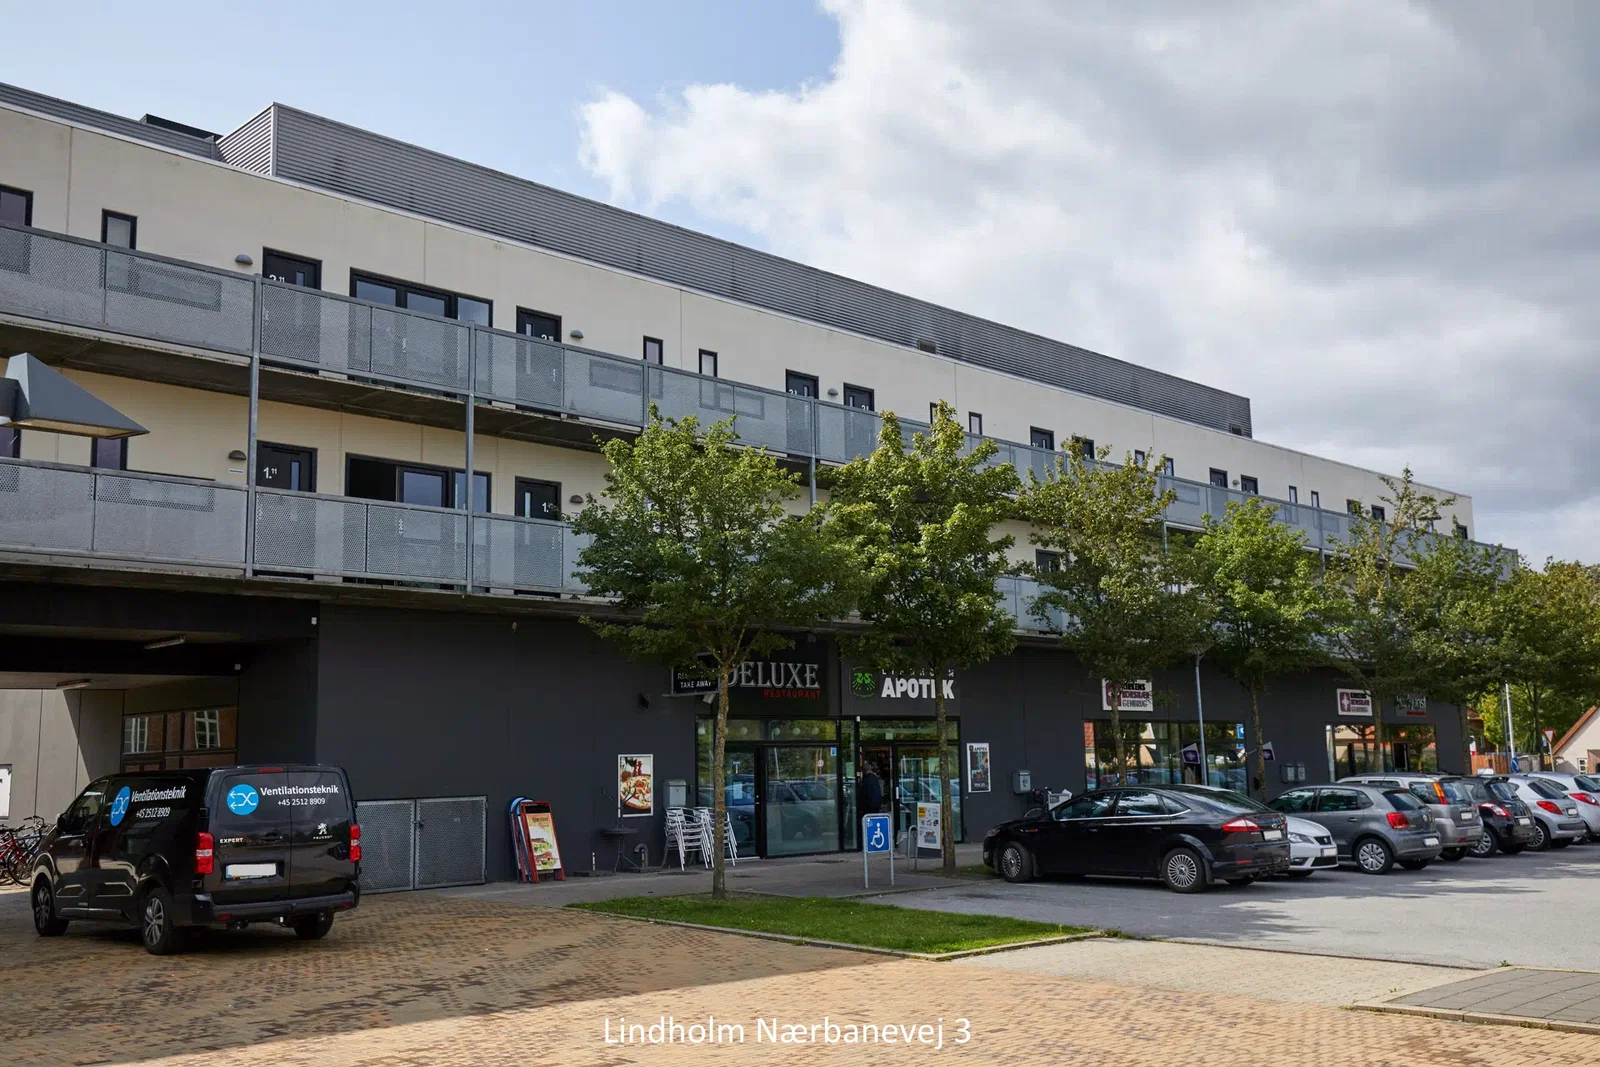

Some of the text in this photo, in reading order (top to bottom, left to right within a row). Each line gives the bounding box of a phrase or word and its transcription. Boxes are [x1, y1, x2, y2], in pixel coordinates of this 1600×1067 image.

[680, 681, 695, 689] TAKE
[763, 689, 820, 699] RESTAURANT
[131, 786, 187, 802] Ventilationsteknik
[260, 785, 339, 796] Ventilationsteknik
[136, 807, 171, 818] +45 2512 8909
